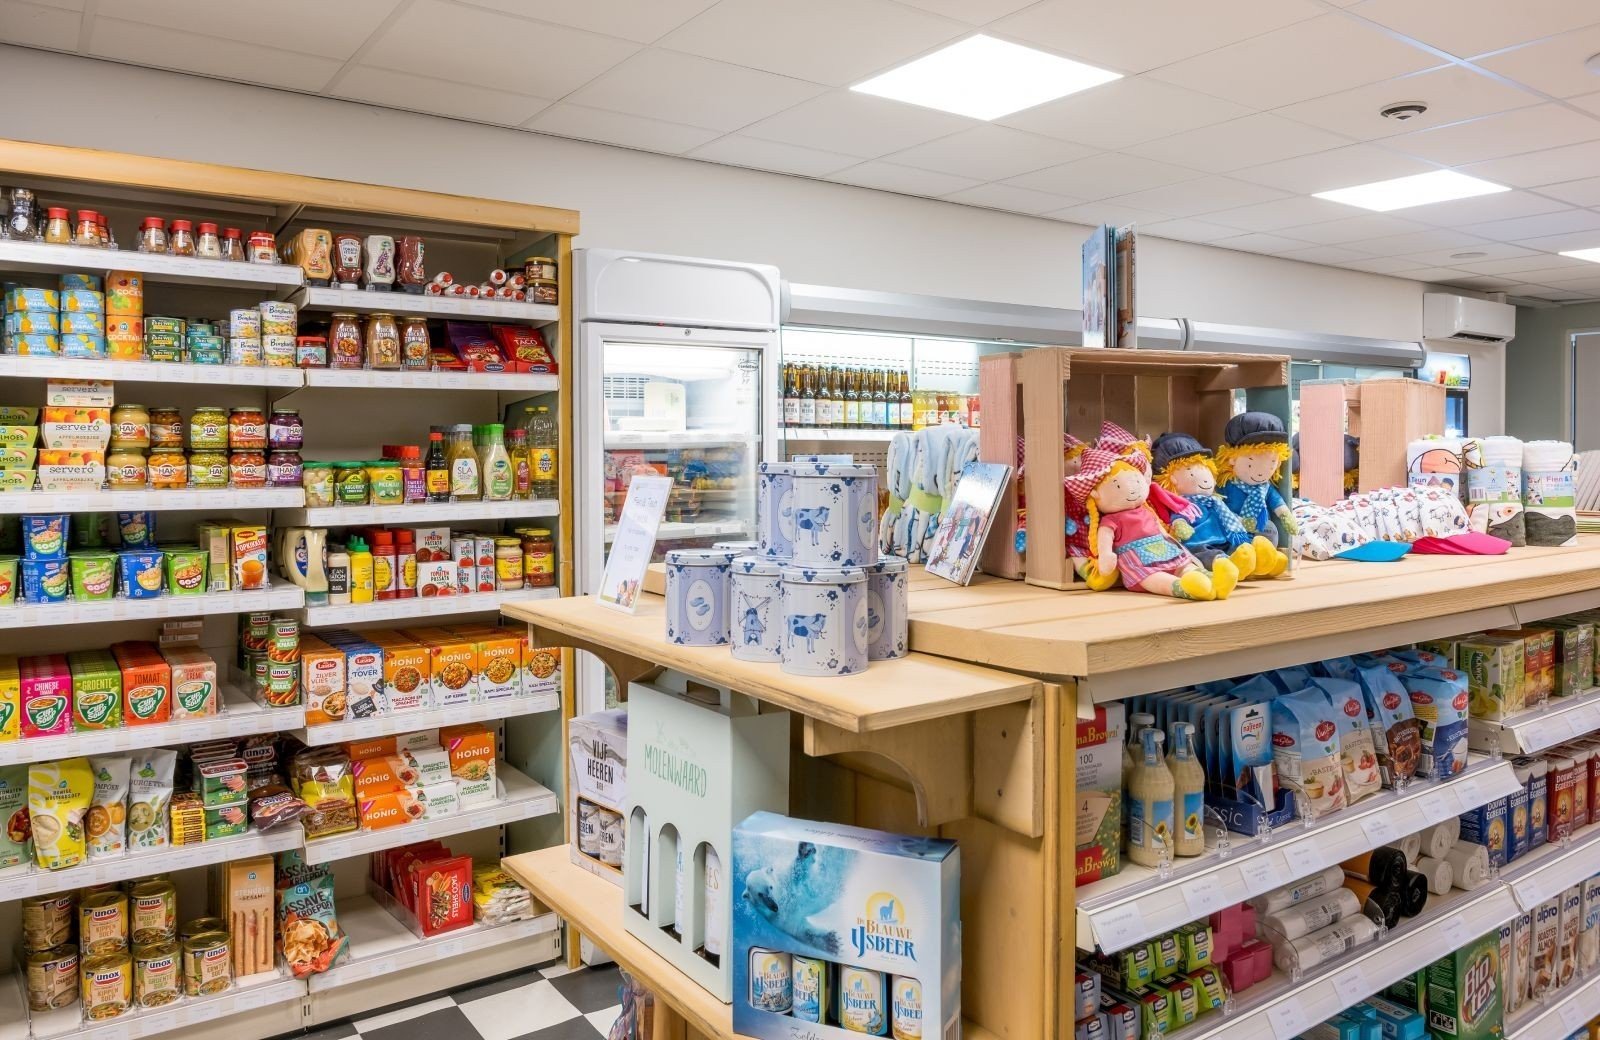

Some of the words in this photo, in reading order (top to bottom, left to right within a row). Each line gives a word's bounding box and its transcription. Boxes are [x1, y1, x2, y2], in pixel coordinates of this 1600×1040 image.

[458, 466, 473, 475] SLA
[86, 580, 111, 591] GOOD
[179, 574, 202, 585] GOOD
[440, 652, 472, 662] HONIG
[484, 648, 514, 657] HONIG
[391, 656, 424, 667] HONIG
[134, 672, 160, 684] TOMAAT
[352, 670, 378, 678] TOVER
[34, 680, 60, 692] CHINESE
[82, 678, 112, 690] GROENTE
[246, 747, 271, 756] unox
[360, 746, 382, 755] HONIG
[456, 746, 490, 759] HONIG
[592, 739, 608, 760] VIJF
[1080, 753, 1094, 765] 100
[588, 758, 614, 785] HEEREN
[644, 744, 708, 798] MOLENWAARD
[358, 774, 390, 786] HONIG
[1082, 800, 1088, 813] 4
[1487, 798, 1506, 812] DOUWE
[366, 808, 398, 820] HONIG
[1486, 806, 1508, 820] EGBERTS
[580, 822, 594, 834] EREN
[600, 830, 614, 844] EREN
[280, 891, 326, 920] CASSAVE
[296, 900, 332, 918] KROEPOEK
[1564, 896, 1580, 912] alpro
[94, 908, 116, 918] unox
[1537, 906, 1558, 923] alpro
[96, 924, 116, 933] KIPPEN
[866, 919, 912, 940] BLAUWE
[1498, 926, 1511, 940] pro
[1538, 926, 1557, 942] ROASTED
[207, 948, 226, 958] unox
[150, 960, 172, 968] unox
[96, 972, 119, 981] unox
[1464, 957, 1490, 1002] Bio
[98, 988, 118, 997] KIPPEN
[1470, 975, 1496, 1016] tex
[894, 1001, 922, 1019] IJSBEE
